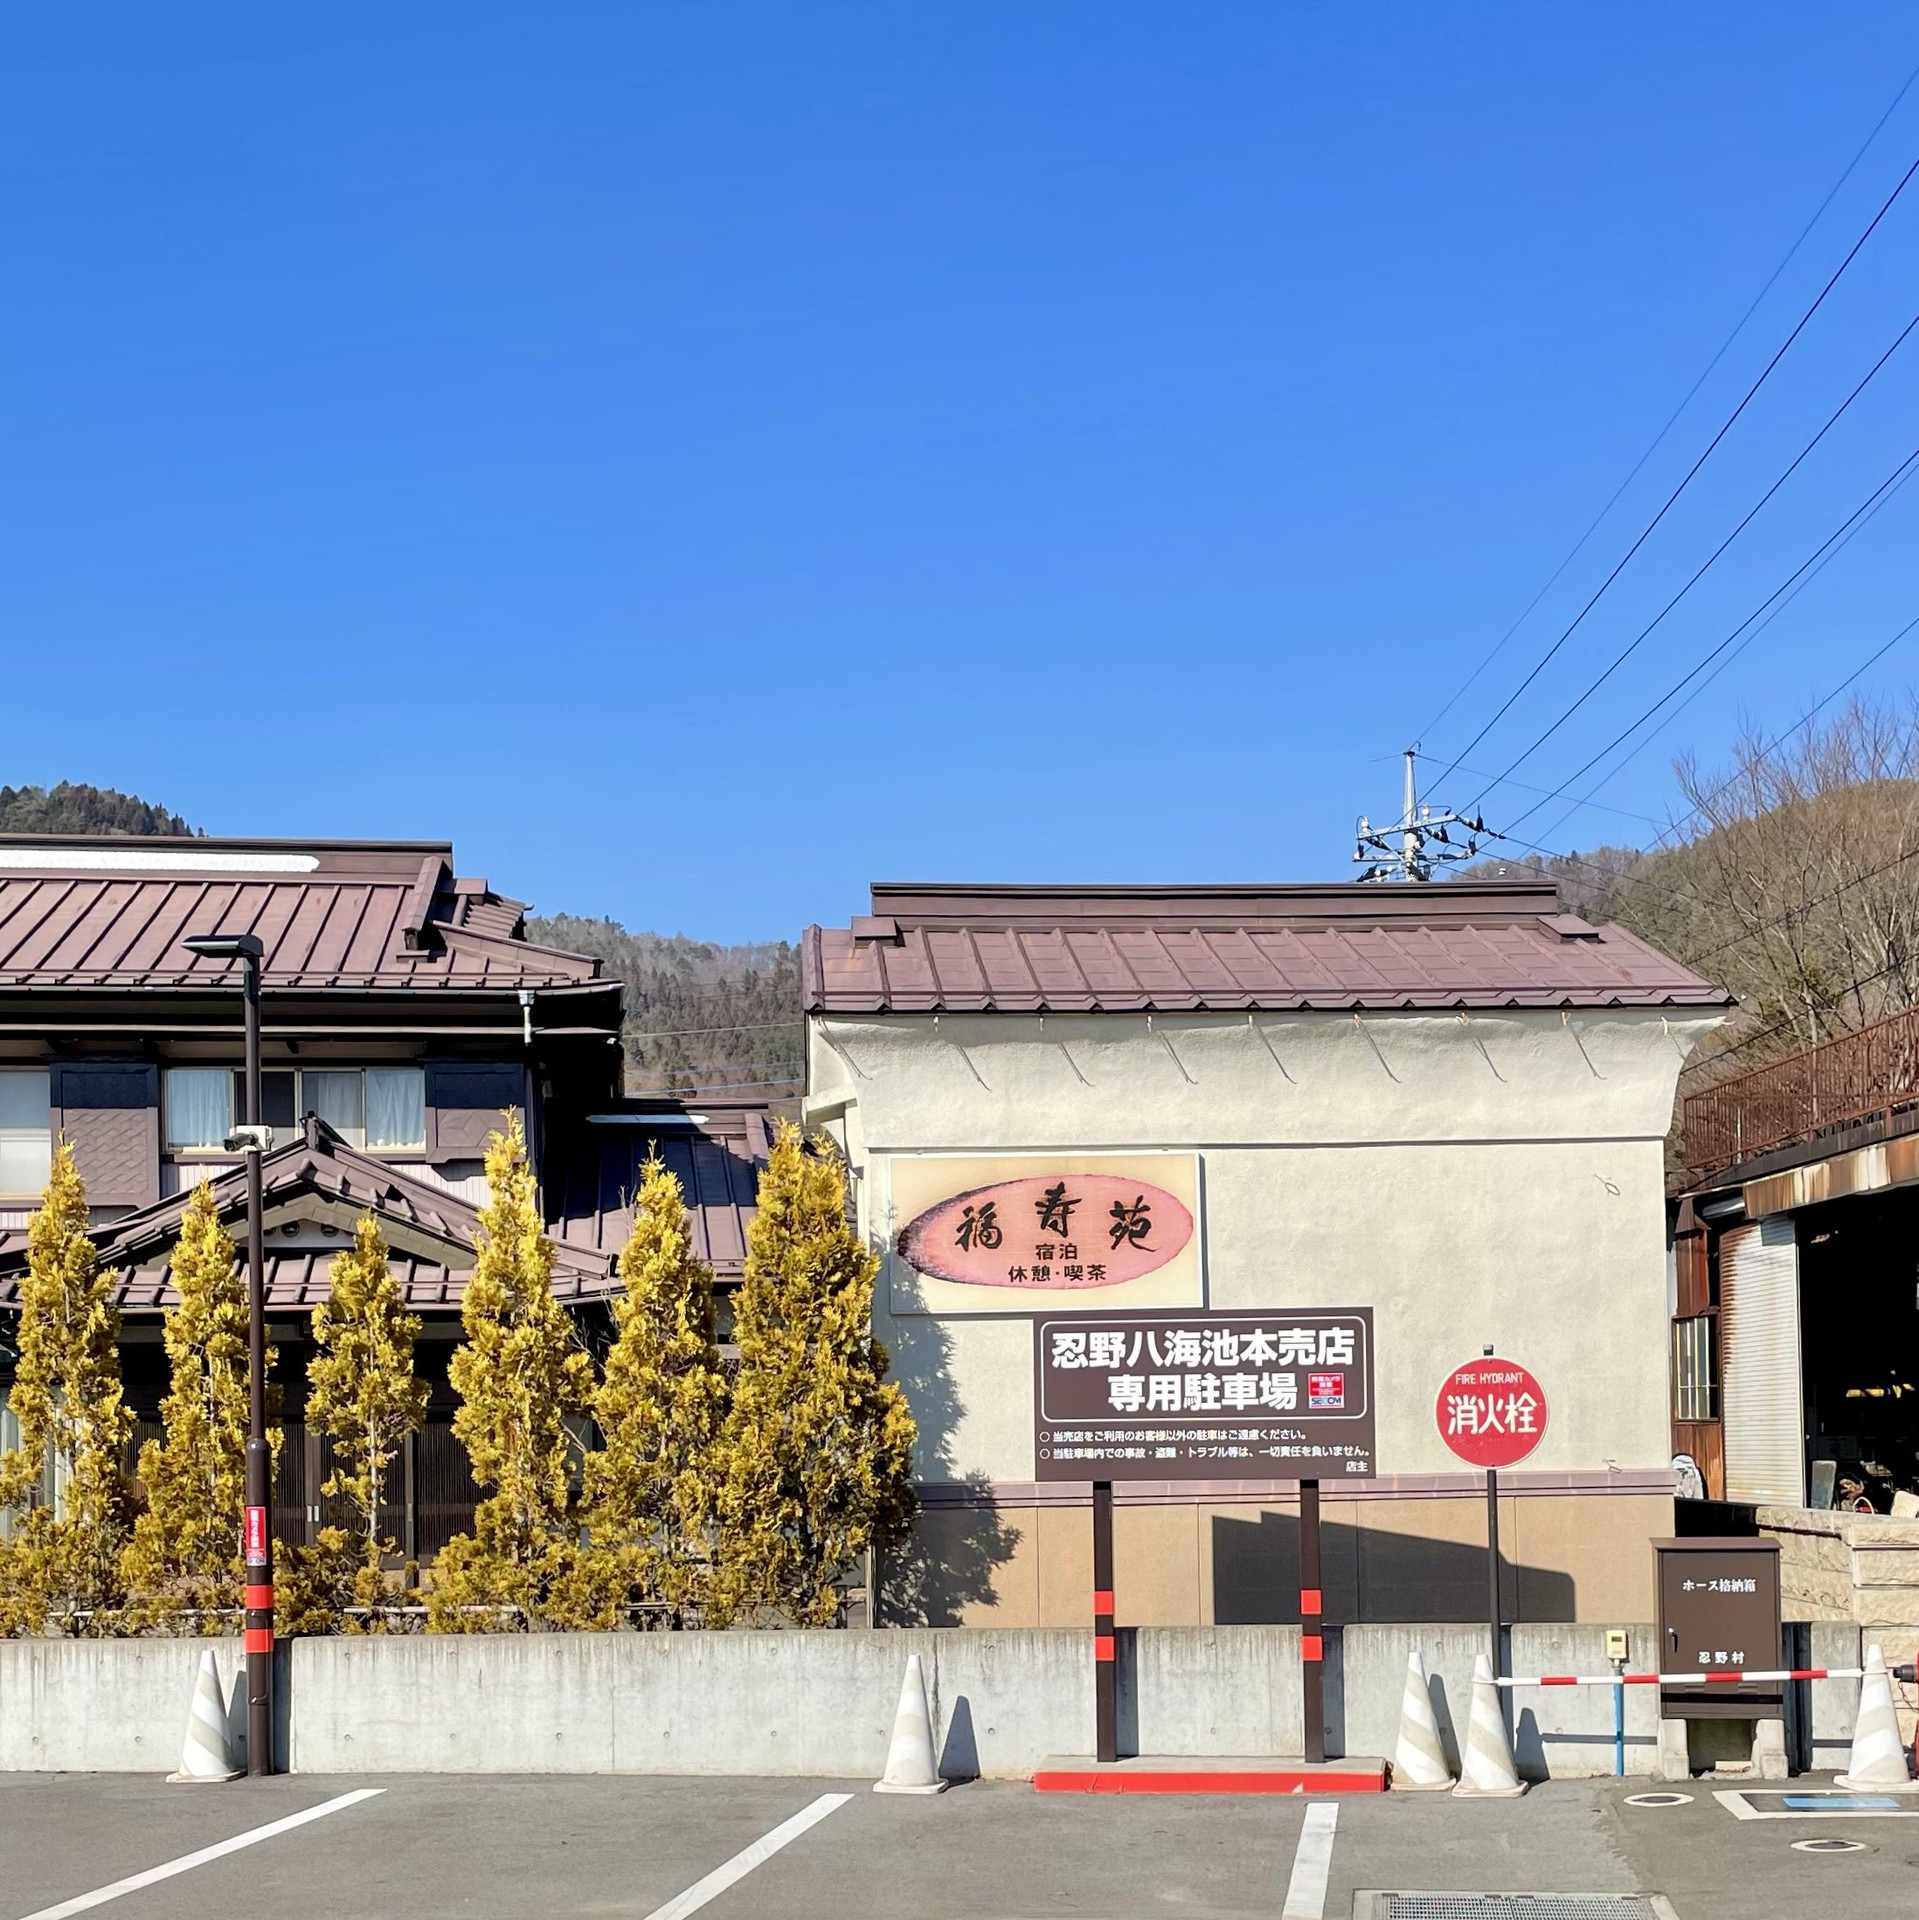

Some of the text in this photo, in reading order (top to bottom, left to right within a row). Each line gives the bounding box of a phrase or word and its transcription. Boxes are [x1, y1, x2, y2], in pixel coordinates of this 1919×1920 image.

[954, 1181, 1159, 1253] 福寿苑
[1035, 1243, 1078, 1260] 宿泊
[1051, 1327, 1355, 1369] 忍野八海池本売店
[1455, 1371, 1524, 1385] FIRE HYDRANT
[1107, 1372, 1298, 1412] 専用駐車場
[1447, 1391, 1538, 1435] 消火栓
[1346, 1461, 1368, 1472] 店主
[1682, 1578, 1756, 1593] ホース格納箱
[1698, 1651, 1745, 1665] 忍野村
